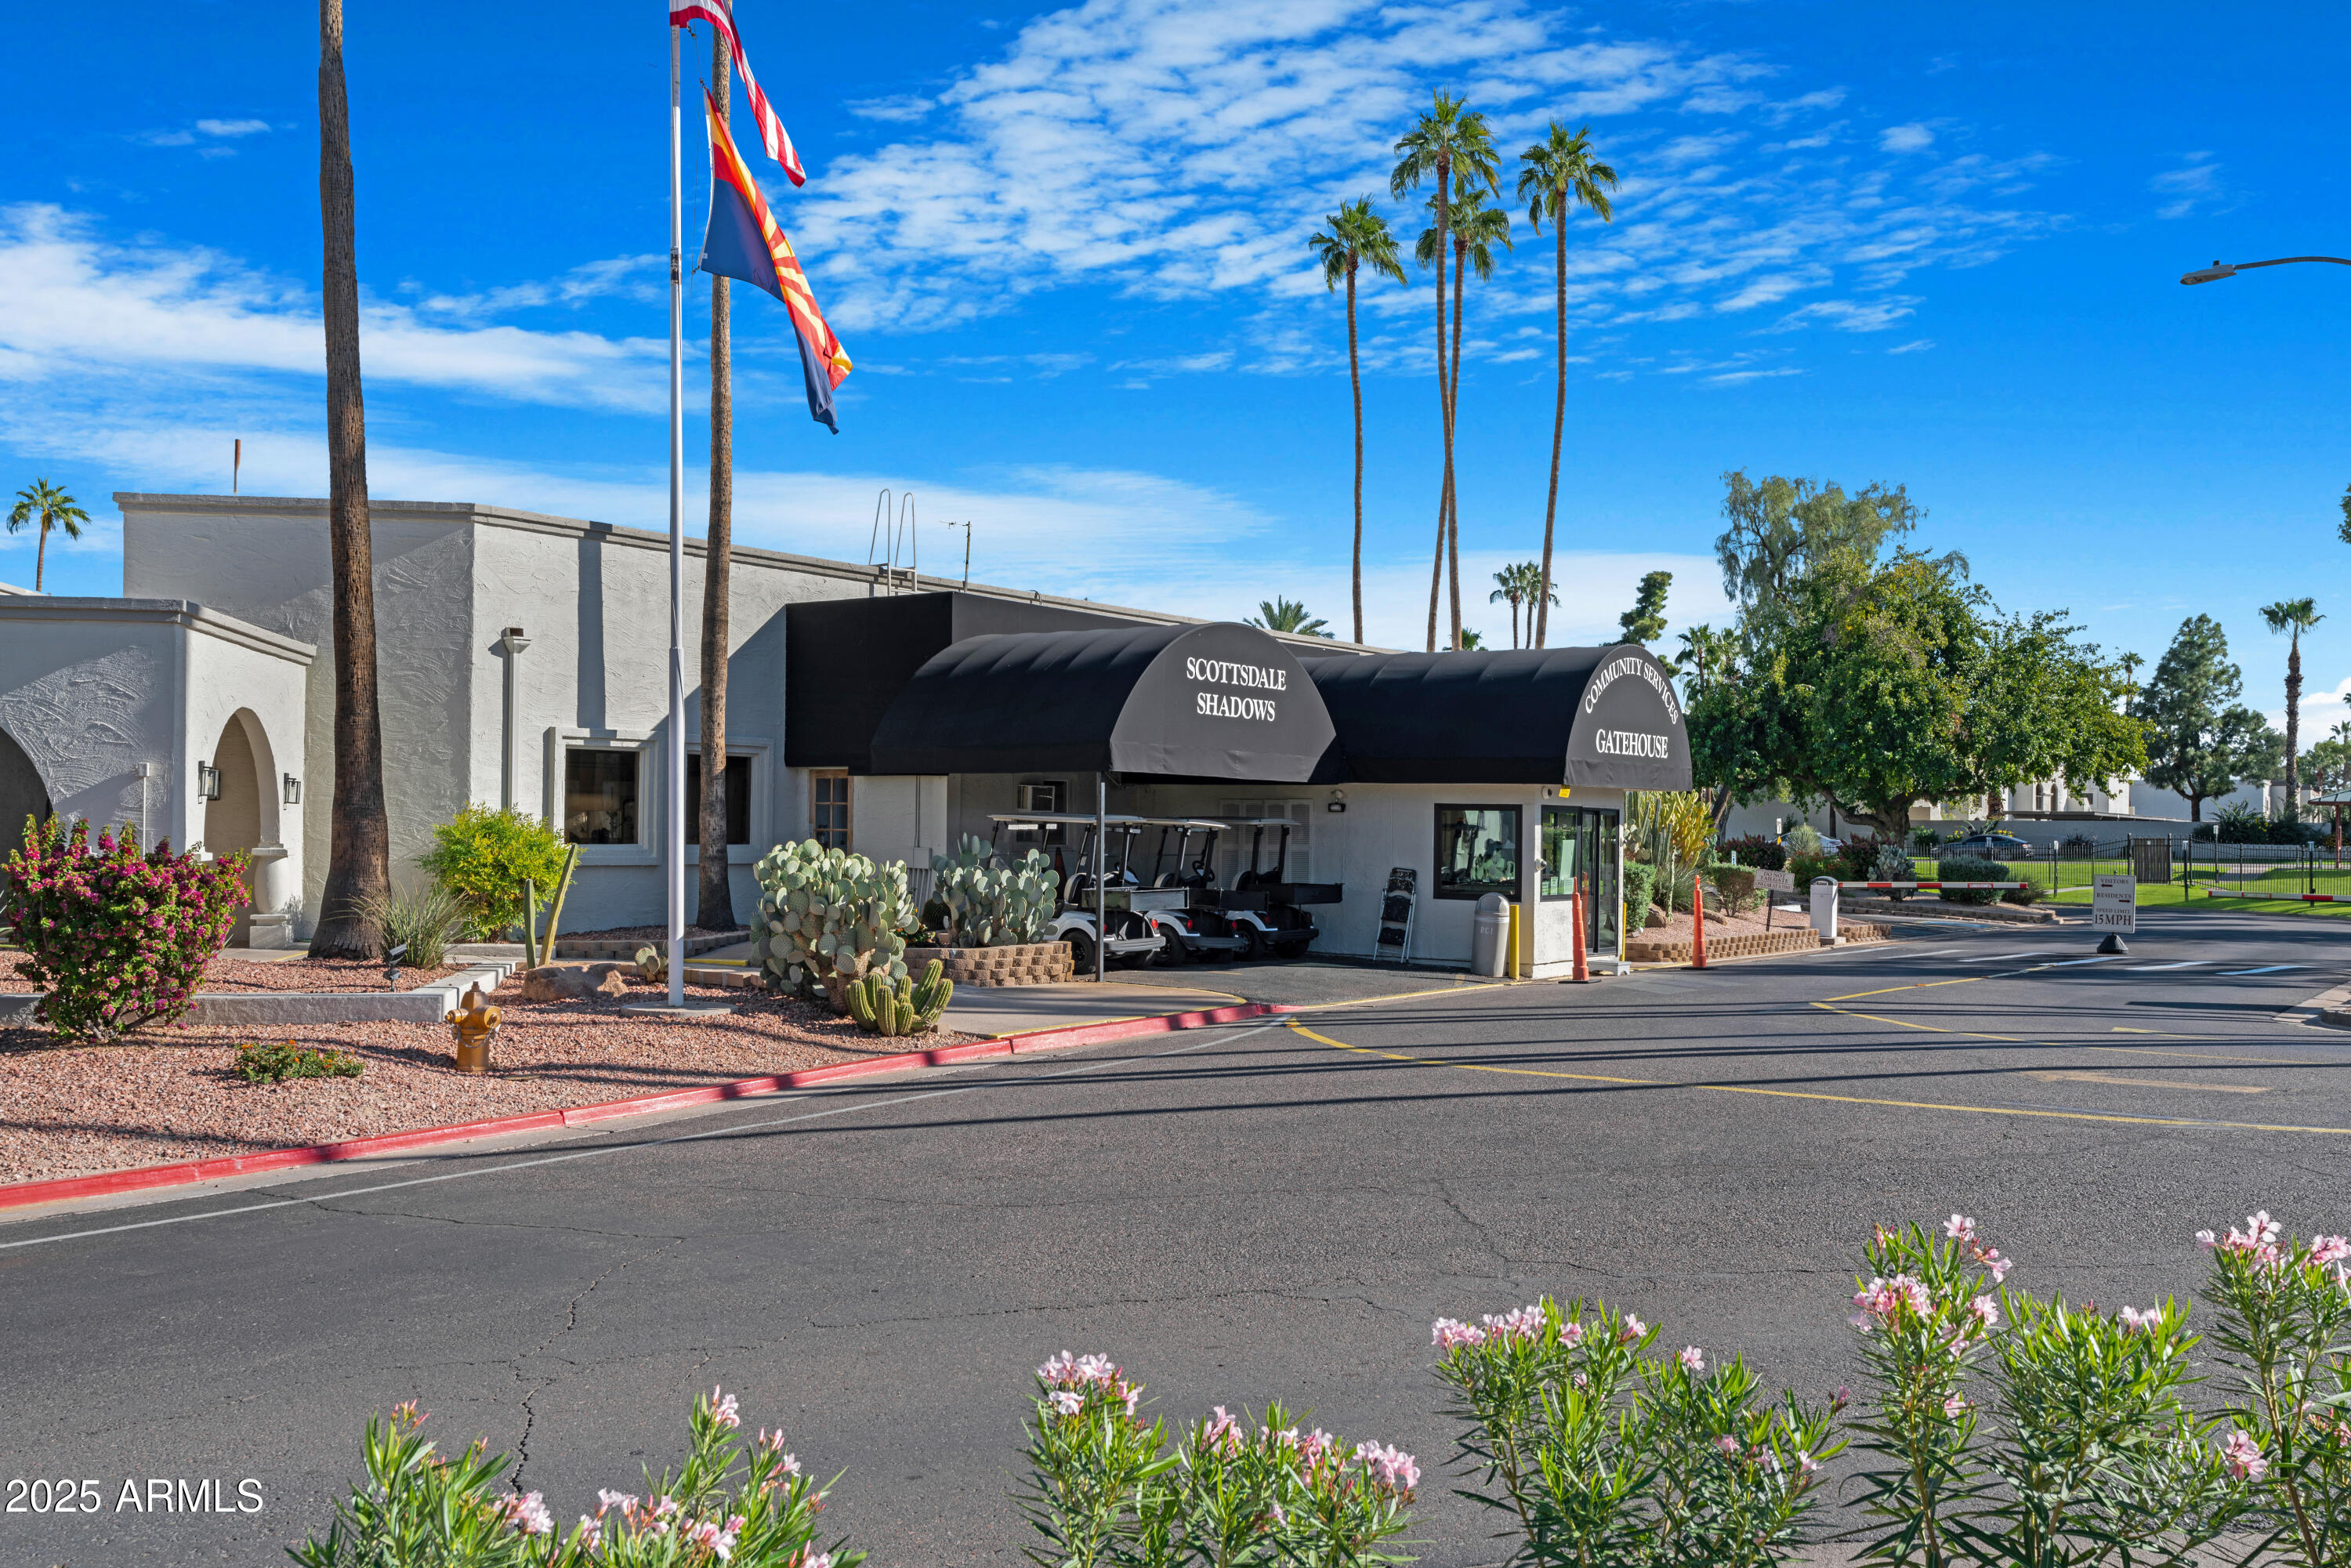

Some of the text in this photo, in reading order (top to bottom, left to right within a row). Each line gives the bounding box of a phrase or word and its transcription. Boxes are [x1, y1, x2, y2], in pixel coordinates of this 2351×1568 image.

[1186, 657, 1287, 691] SCOTTSDALE
[1197, 692, 1276, 722] SHADOWS
[1585, 657, 1679, 725] COMMUNITY SERVICES
[1596, 729, 1668, 759] GATEHOUSE
